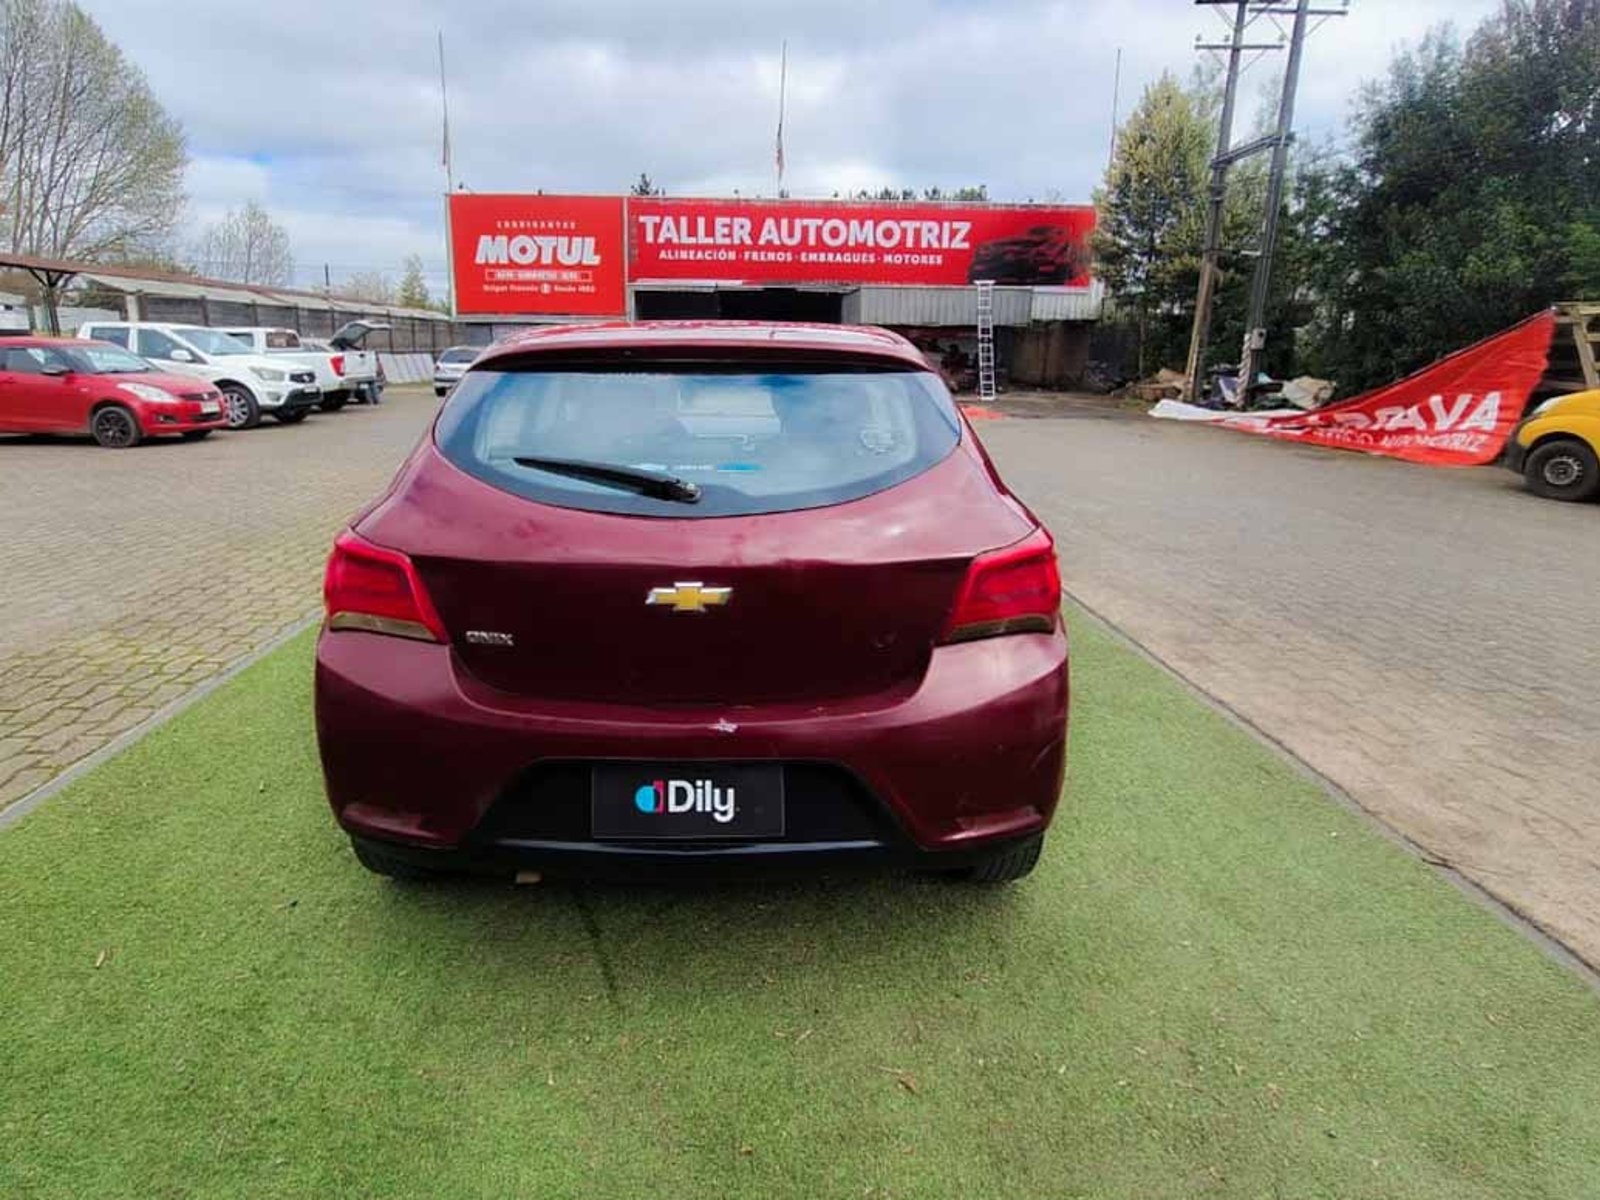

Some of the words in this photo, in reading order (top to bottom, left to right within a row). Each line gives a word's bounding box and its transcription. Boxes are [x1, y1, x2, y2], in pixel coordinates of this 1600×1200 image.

[638, 215, 752, 245] TALLER
[758, 217, 972, 249] AUTOMOTRIZ
[475, 234, 601, 266] MOTUL
[659, 249, 736, 261] ALINEACIÓN
[744, 251, 793, 262] FRENOS
[801, 252, 876, 264] EMBRAGUES
[883, 254, 943, 266] MOTORES
[465, 630, 514, 646] ONIX
[668, 780, 735, 823] Dily
